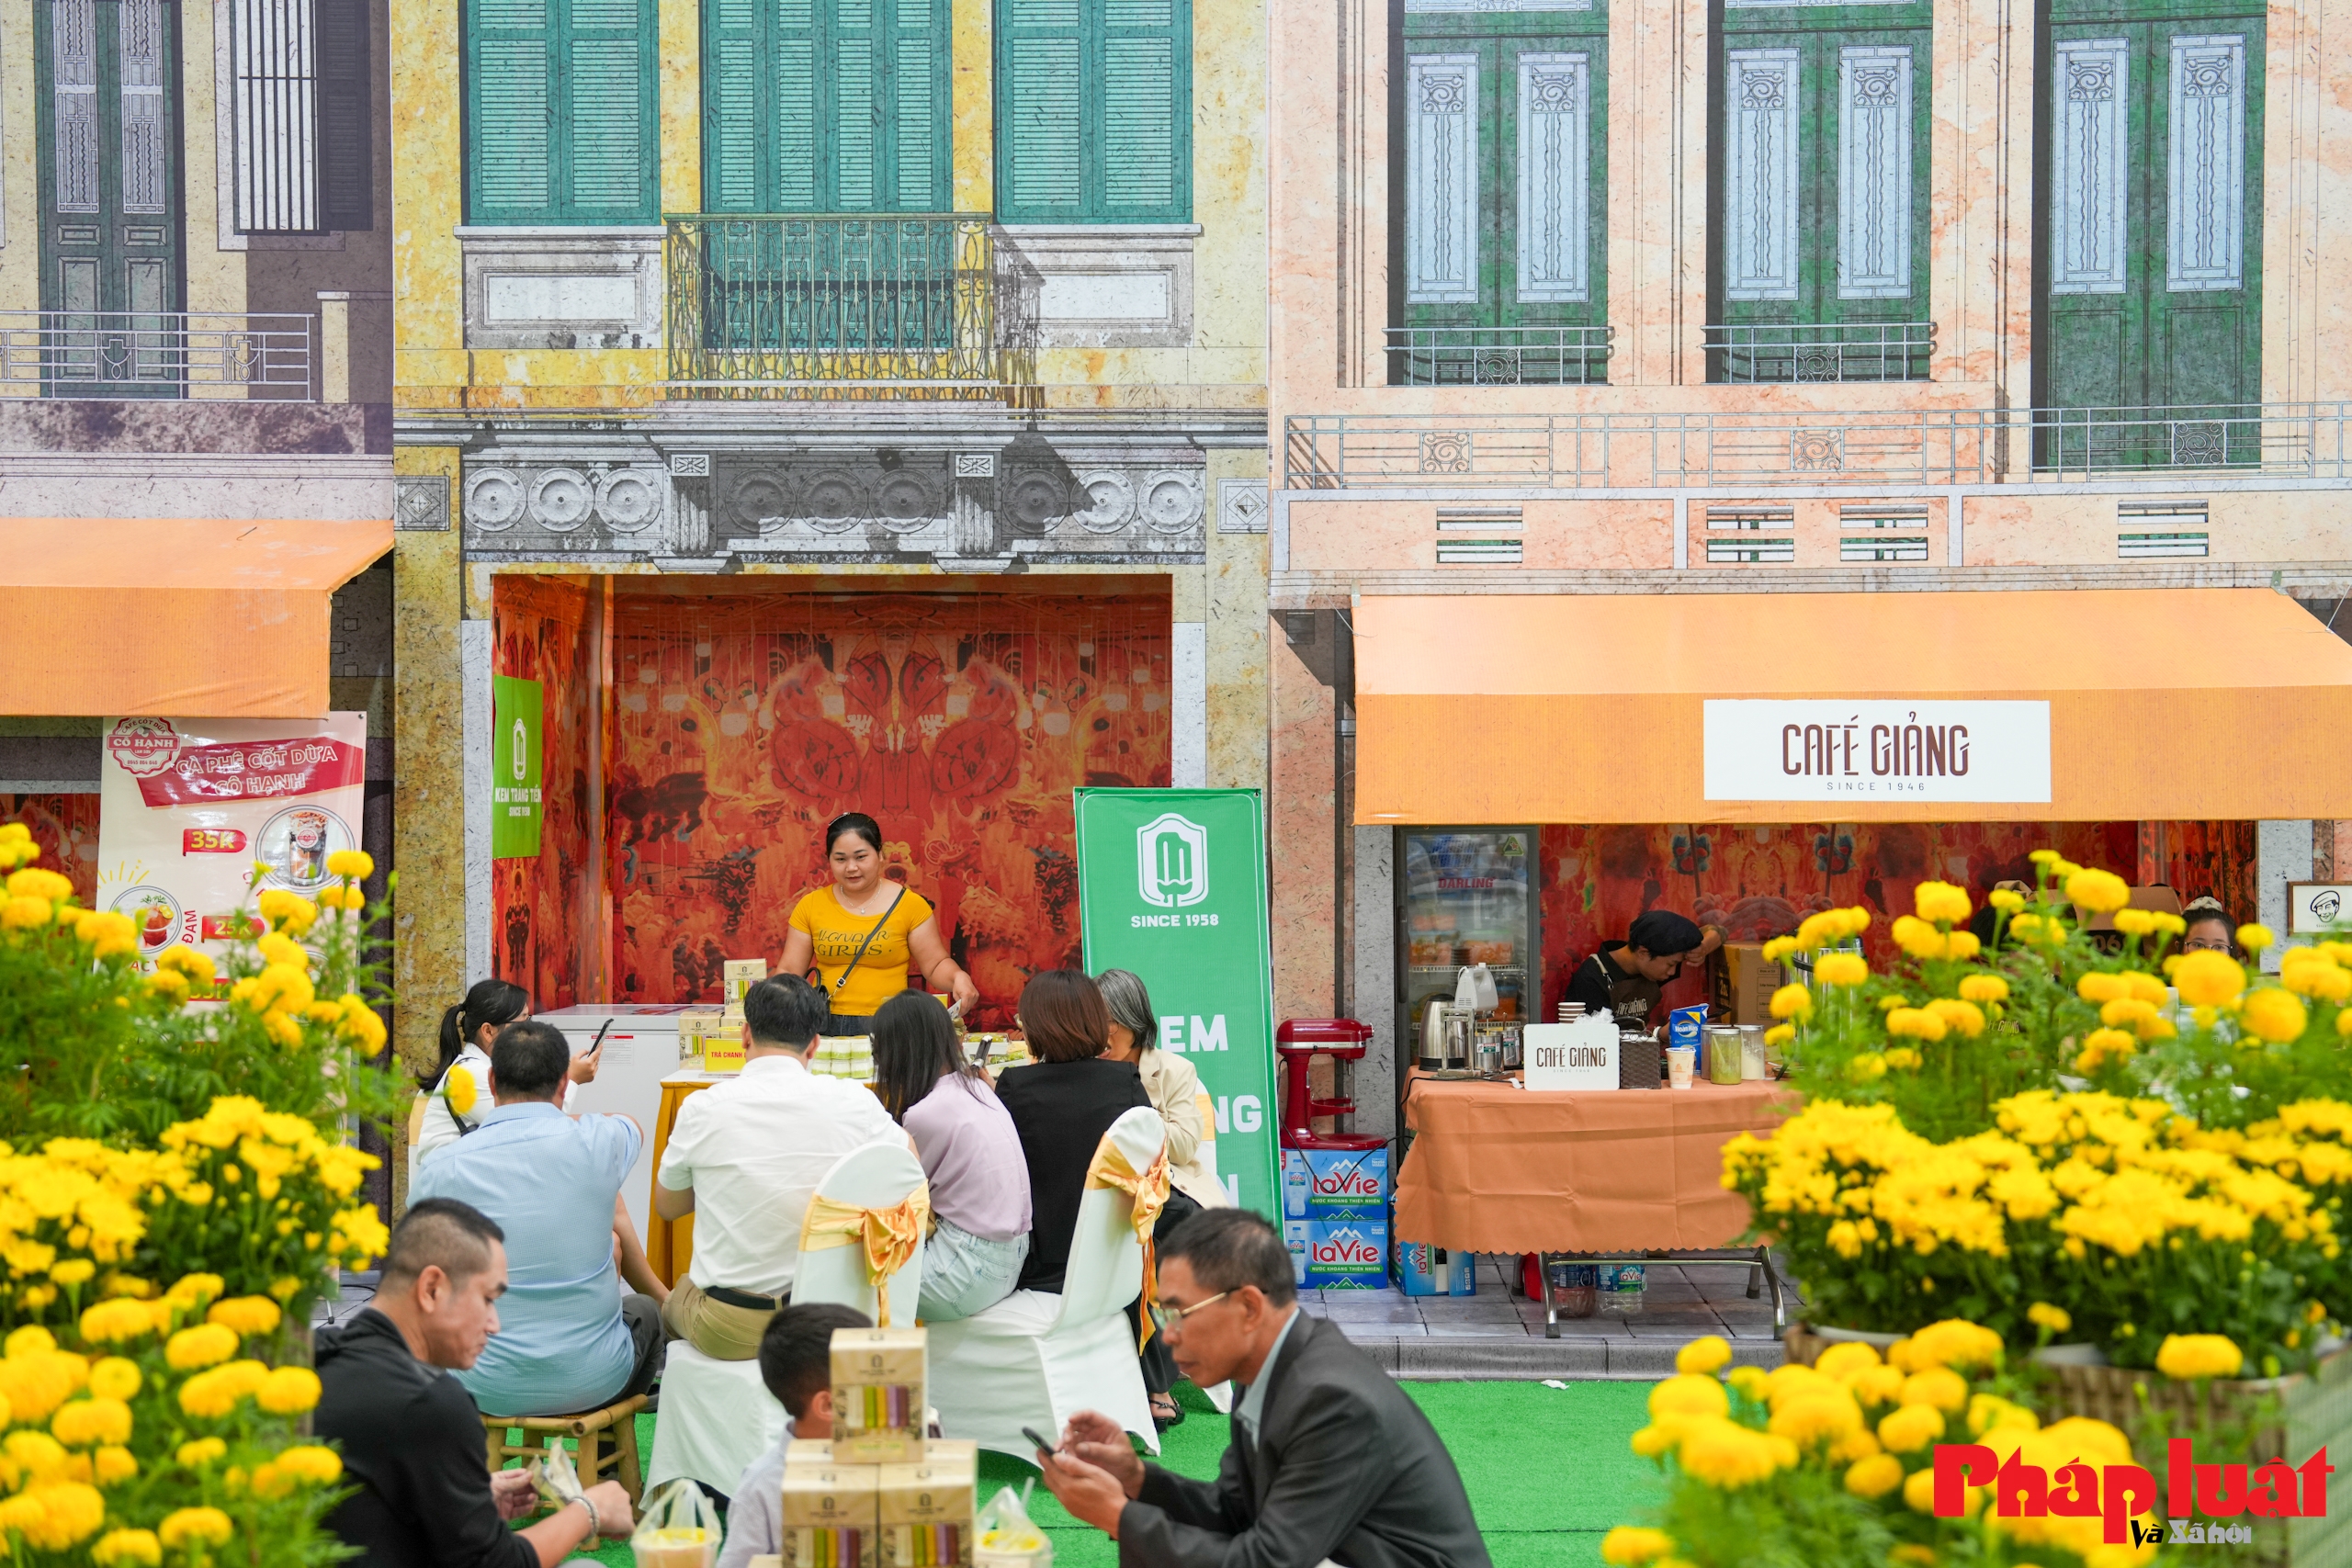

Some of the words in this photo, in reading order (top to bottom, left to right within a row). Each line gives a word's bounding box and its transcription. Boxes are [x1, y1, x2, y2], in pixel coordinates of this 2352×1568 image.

[113, 737, 130, 746] CÔ
[134, 739, 174, 749] HẠNH
[1782, 714, 1859, 776] CAFÉ
[1871, 711, 1970, 776] GIẢNG
[175, 755, 204, 776] CÀ
[207, 750, 244, 773] PHÊ
[247, 746, 288, 769] CỐT
[290, 744, 338, 765] DỪA
[214, 776, 243, 796] CÔ
[246, 773, 306, 795] HẠNH
[494, 787, 510, 803] KEM
[510, 783, 529, 803] TRÀNG
[1826, 782, 1876, 791] SINCE
[1888, 783, 1925, 791] 1946
[508, 807, 521, 817] SINCE
[190, 830, 236, 849] 35K
[1438, 877, 1494, 889] DARLING
[1131, 914, 1181, 928] SINCE
[1185, 914, 1219, 927] 1958
[1159, 1014, 1229, 1053] EM
[711, 1050, 722, 1058] TRÀ
[1536, 1043, 1566, 1066] CAFÉ
[1569, 1042, 1607, 1067] GIẢNG
[1313, 1171, 1380, 1194] laVie
[1312, 1239, 1379, 1262] laVie
[1619, 1271, 1642, 1281] laVie
